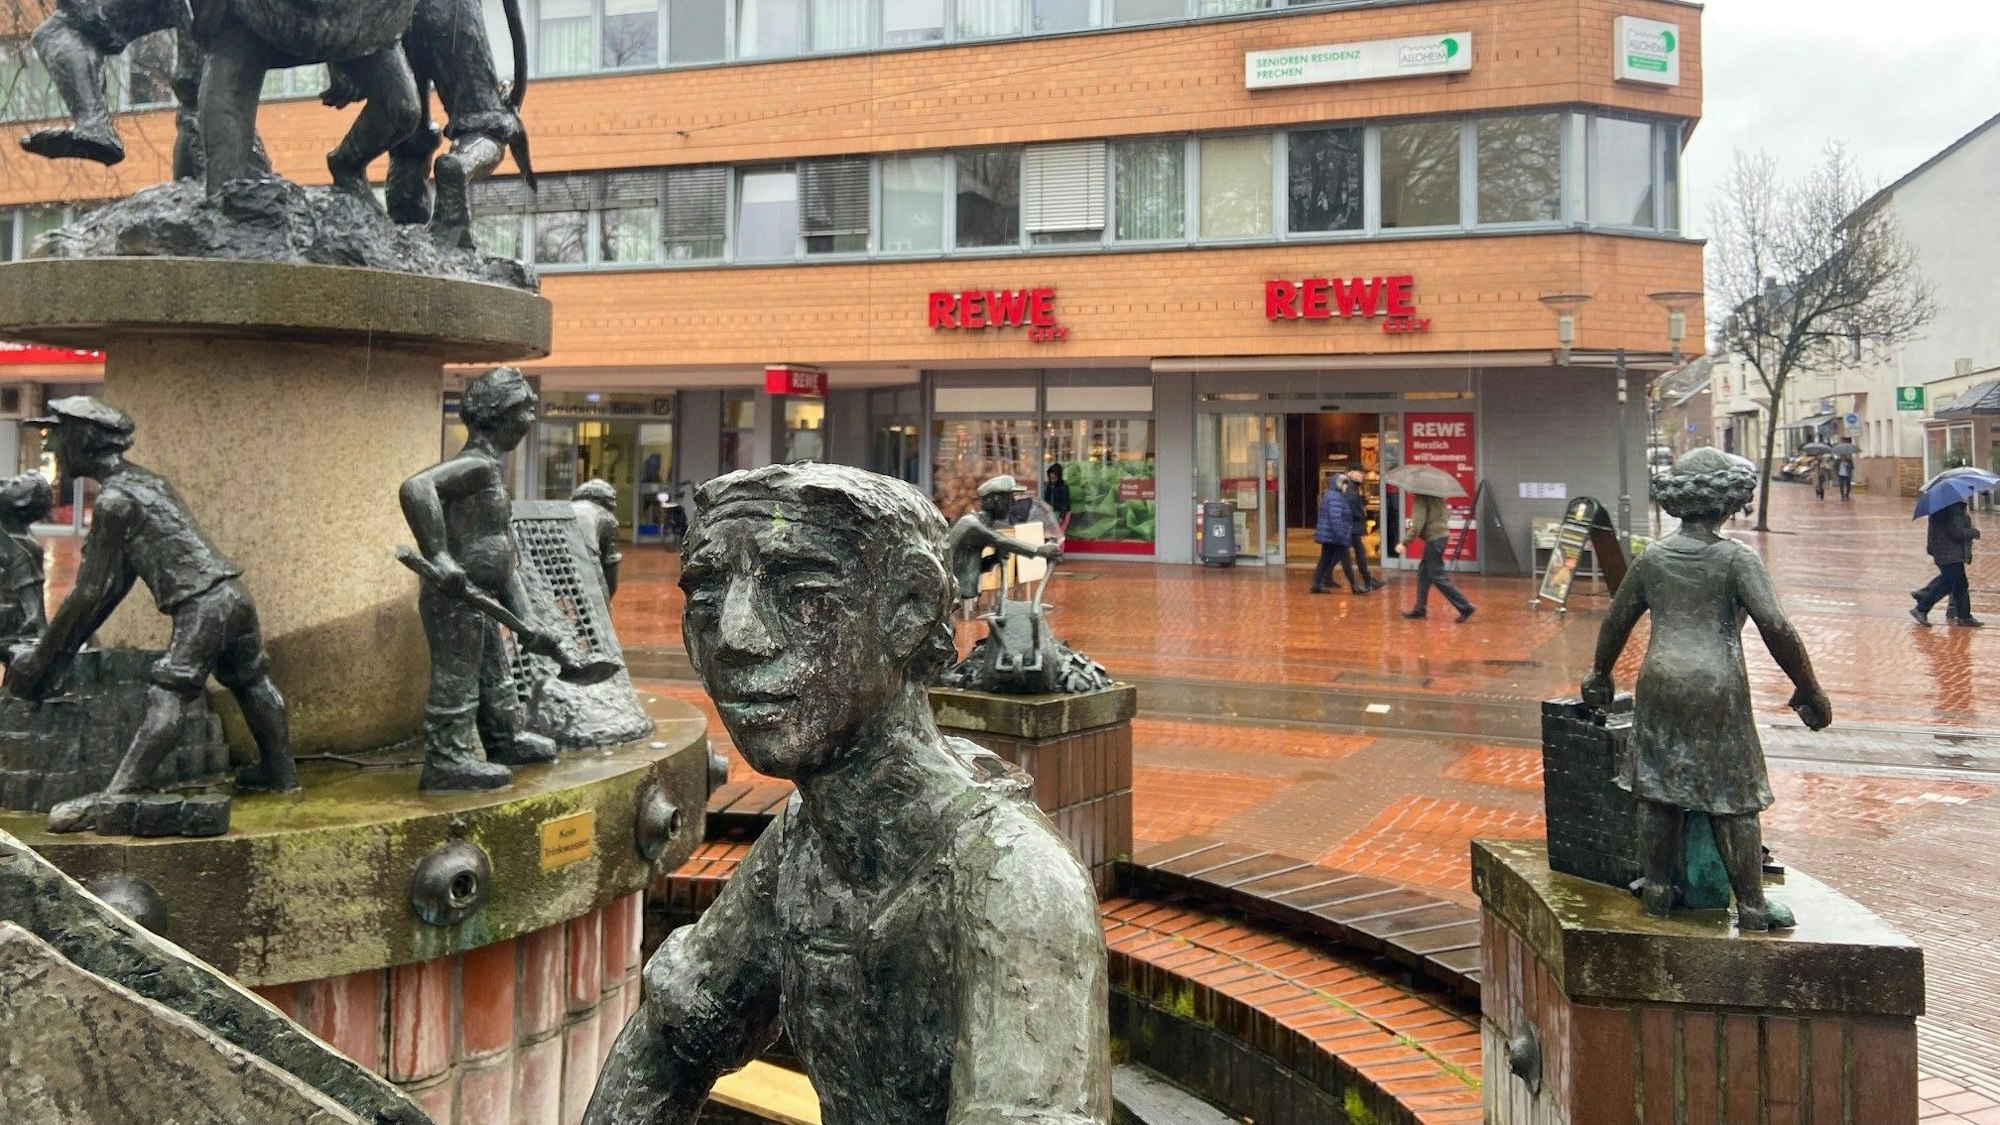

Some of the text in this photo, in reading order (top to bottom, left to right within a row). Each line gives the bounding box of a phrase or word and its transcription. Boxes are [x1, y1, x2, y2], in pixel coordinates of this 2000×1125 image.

[1256, 50, 1446, 68] SENIOREN RESIDENZ ALLOHEIM
[1256, 67, 1303, 79] FRECHEN
[1266, 276, 1416, 320] REWE
[929, 287, 1056, 329] REWE
[1028, 327, 1070, 342] CITY
[792, 371, 819, 390] REWE
[546, 402, 608, 415] Deutsche
[1412, 422, 1466, 437] REWE
[1413, 440, 1449, 449] Herzlich
[1413, 452, 1466, 461] willkommen
[559, 828, 577, 839] Kein
[545, 839, 590, 857] Trinkwasser
